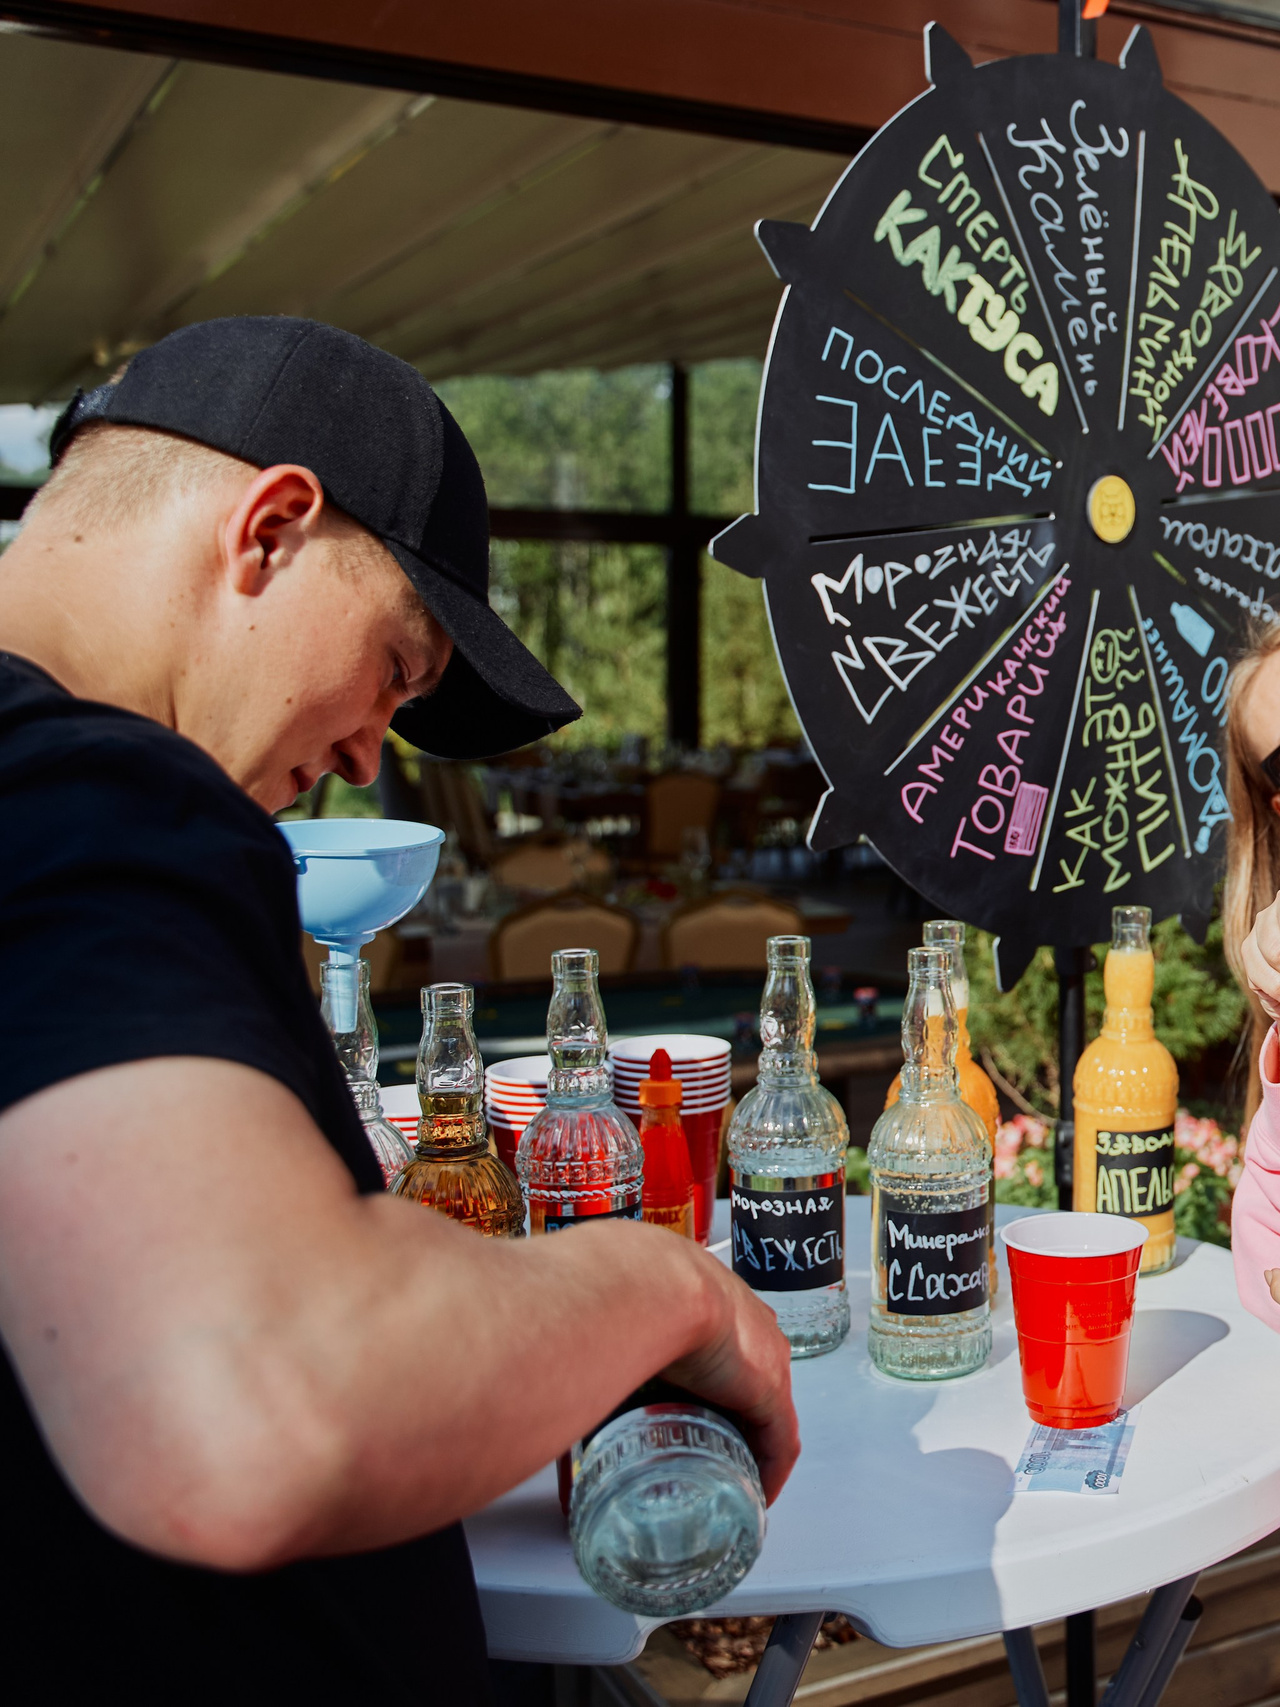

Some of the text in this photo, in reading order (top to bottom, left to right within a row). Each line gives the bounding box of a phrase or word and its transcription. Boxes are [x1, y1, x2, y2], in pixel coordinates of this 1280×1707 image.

[874, 189, 1059, 417] КАКТУСА
[1006, 118, 1096, 396] Камень
[1069, 99, 1129, 346] Зелёный
[1131, 138, 1219, 428] АПЕЛЬСИН
[808, 395, 1031, 496] ЗАЕЗД
[822, 326, 1051, 489] ПОСЛЕДНИЙ
[831, 543, 1055, 724] СВЕЖЕСТЬ
[1053, 777, 1101, 893] КАК
[1102, 703, 1130, 893] МОЖНО
[1131, 702, 1175, 872] ПИТЬ
